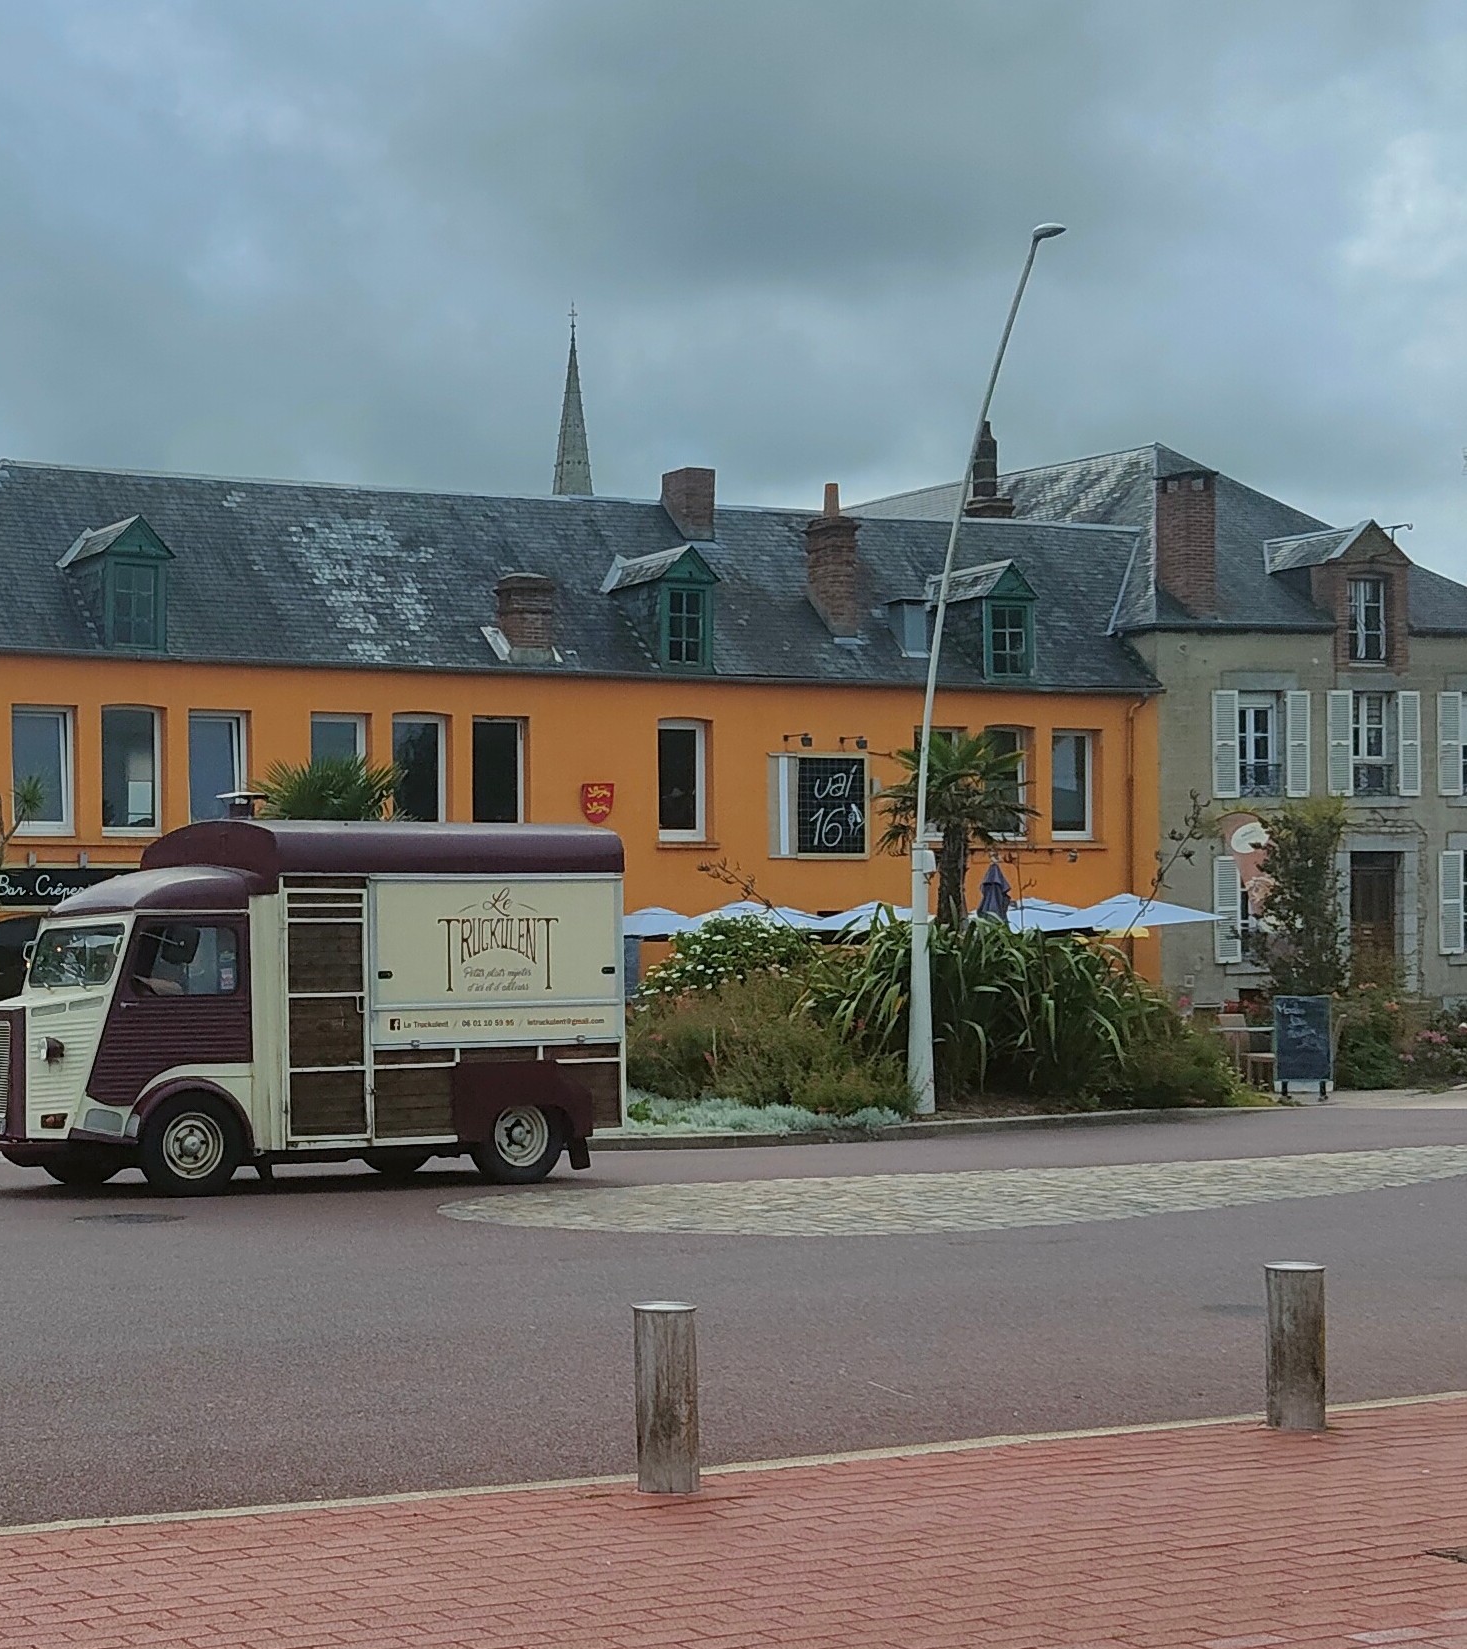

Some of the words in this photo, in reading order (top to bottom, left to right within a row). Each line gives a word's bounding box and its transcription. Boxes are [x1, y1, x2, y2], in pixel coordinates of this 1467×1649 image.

[35, 874, 92, 902] Crêper
[482, 887, 513, 917] Le
[437, 917, 559, 992] TRUCKULENT
[473, 1019, 481, 1027] 01
[483, 1019, 493, 1027] 10
